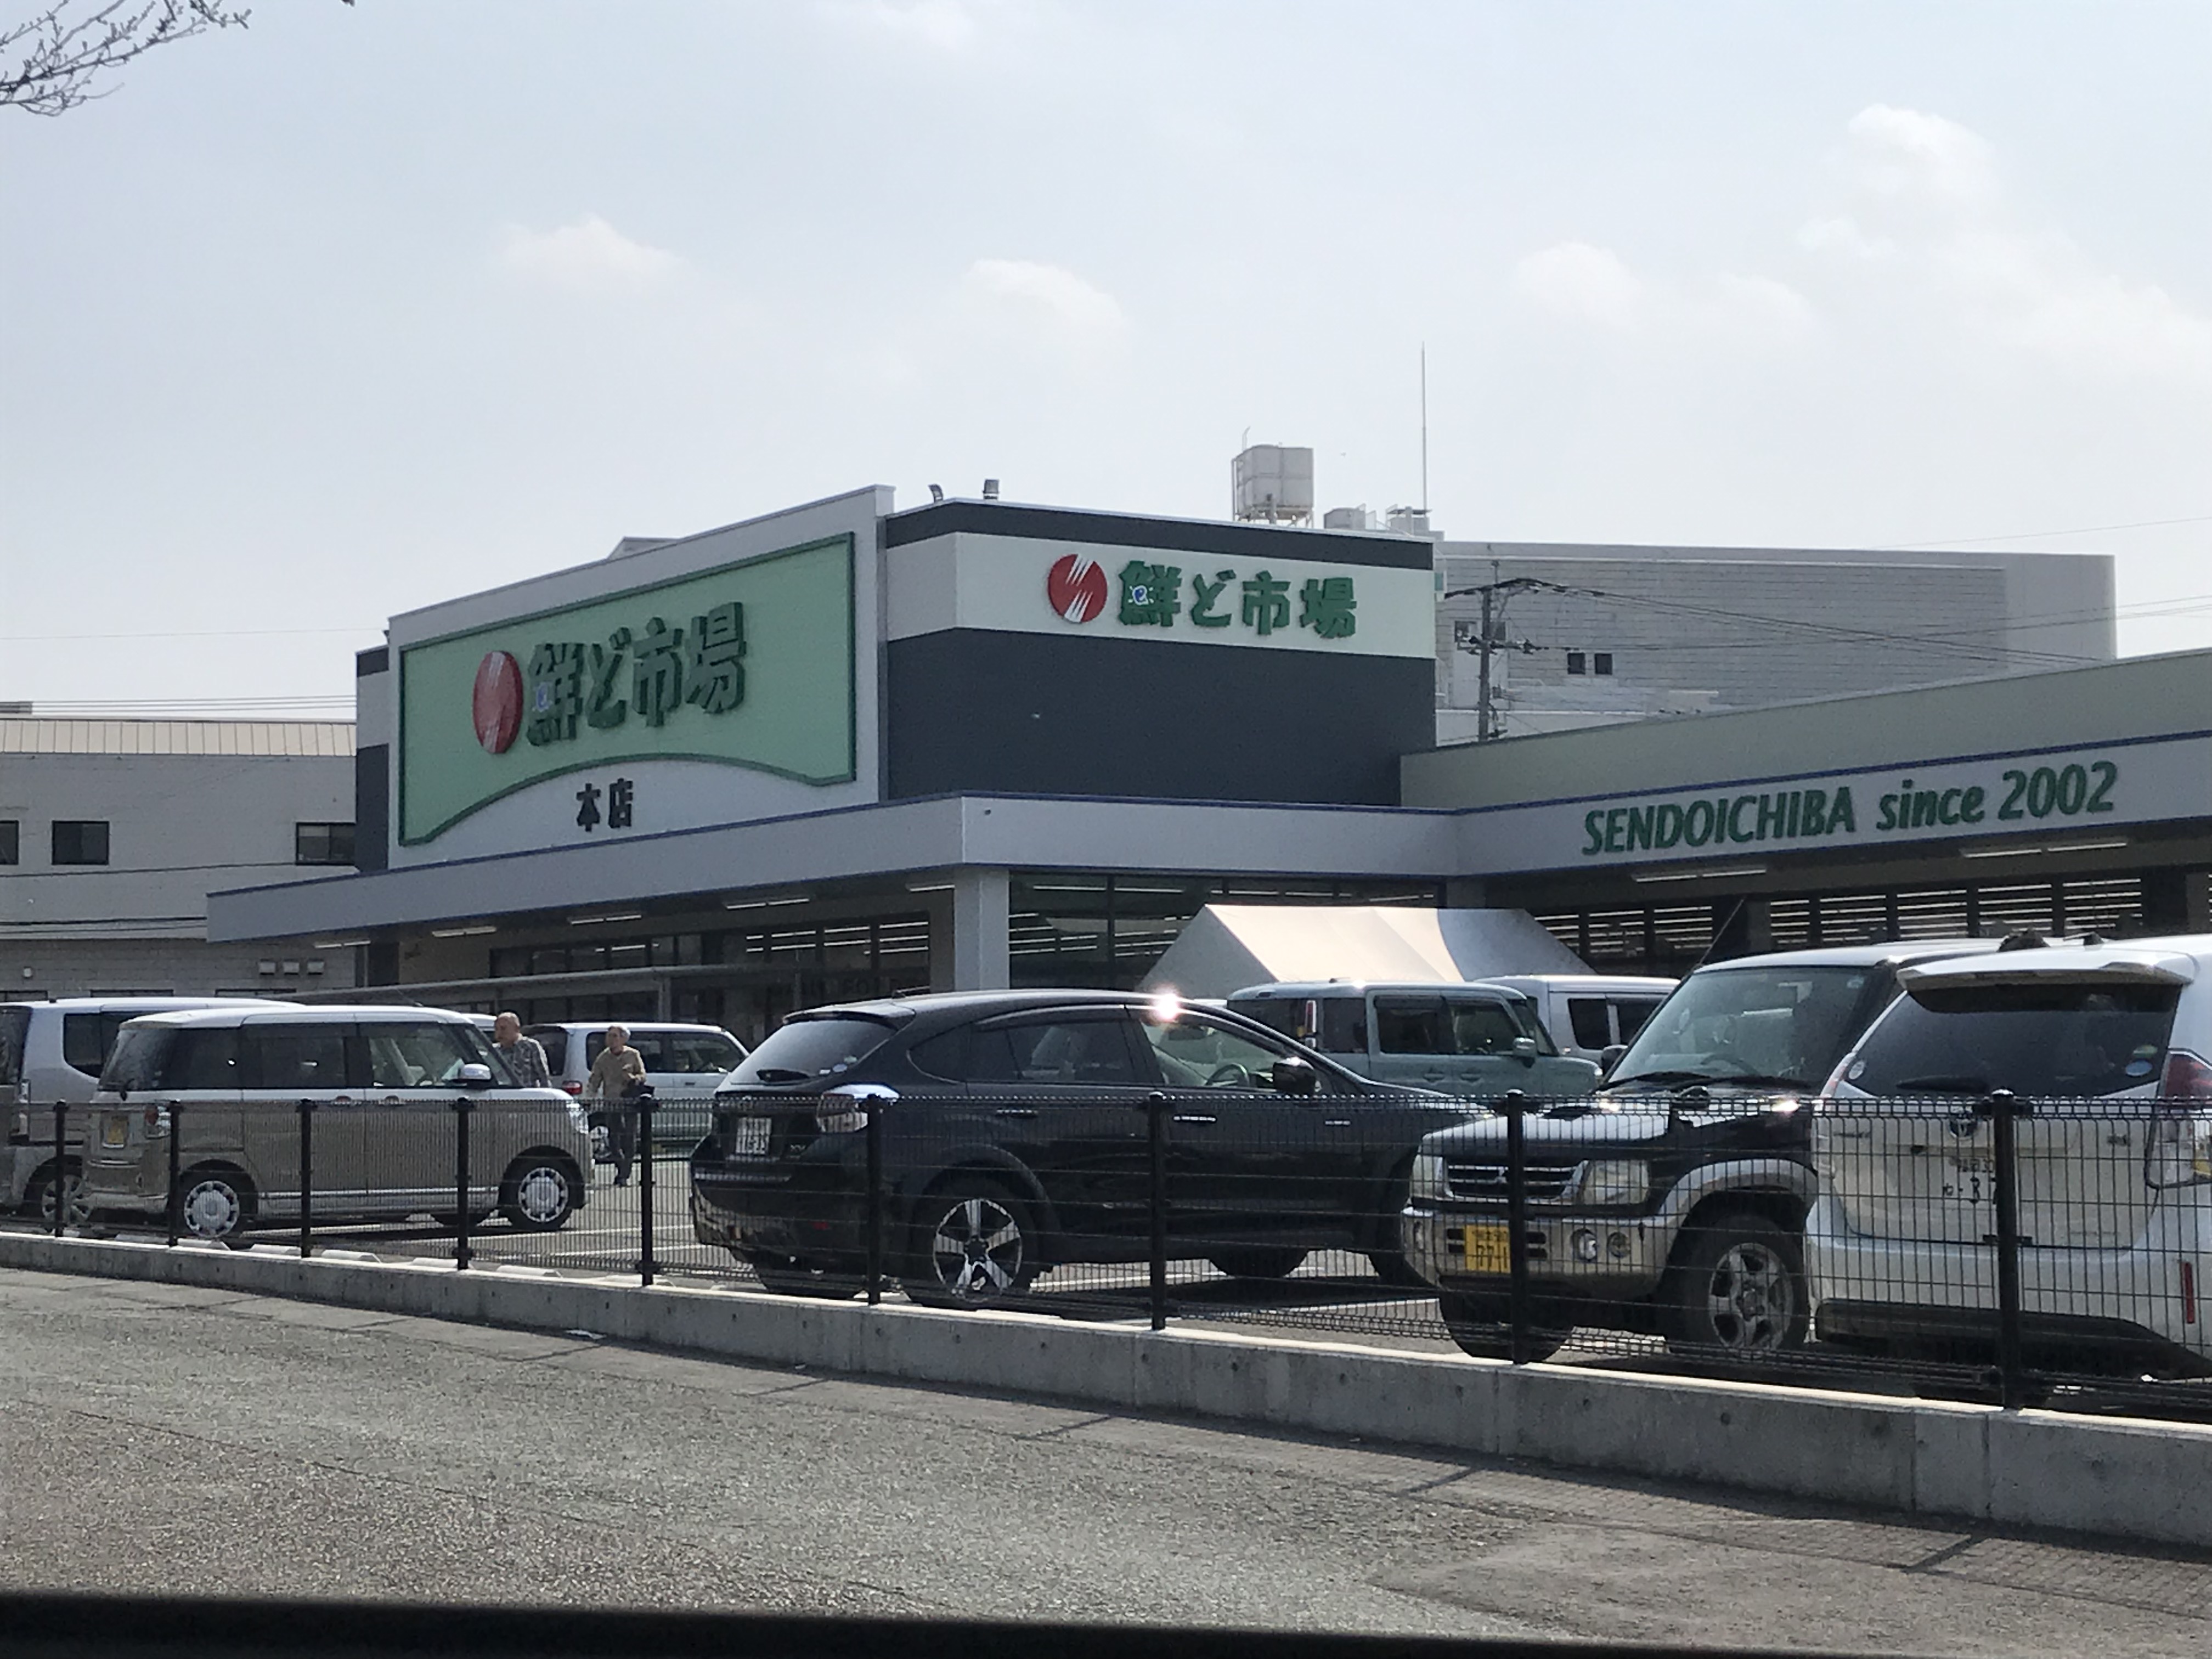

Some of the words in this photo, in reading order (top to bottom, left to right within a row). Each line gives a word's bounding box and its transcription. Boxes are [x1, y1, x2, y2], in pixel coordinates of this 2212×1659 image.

[1119, 560, 1357, 639] 鮮ど市場
[526, 602, 747, 746] 鮮ど市場
[576, 778, 633, 832] 本店
[1582, 787, 1856, 855] SENDOICHIBA
[1876, 779, 1985, 831] since
[1997, 760, 2117, 821] 2002
